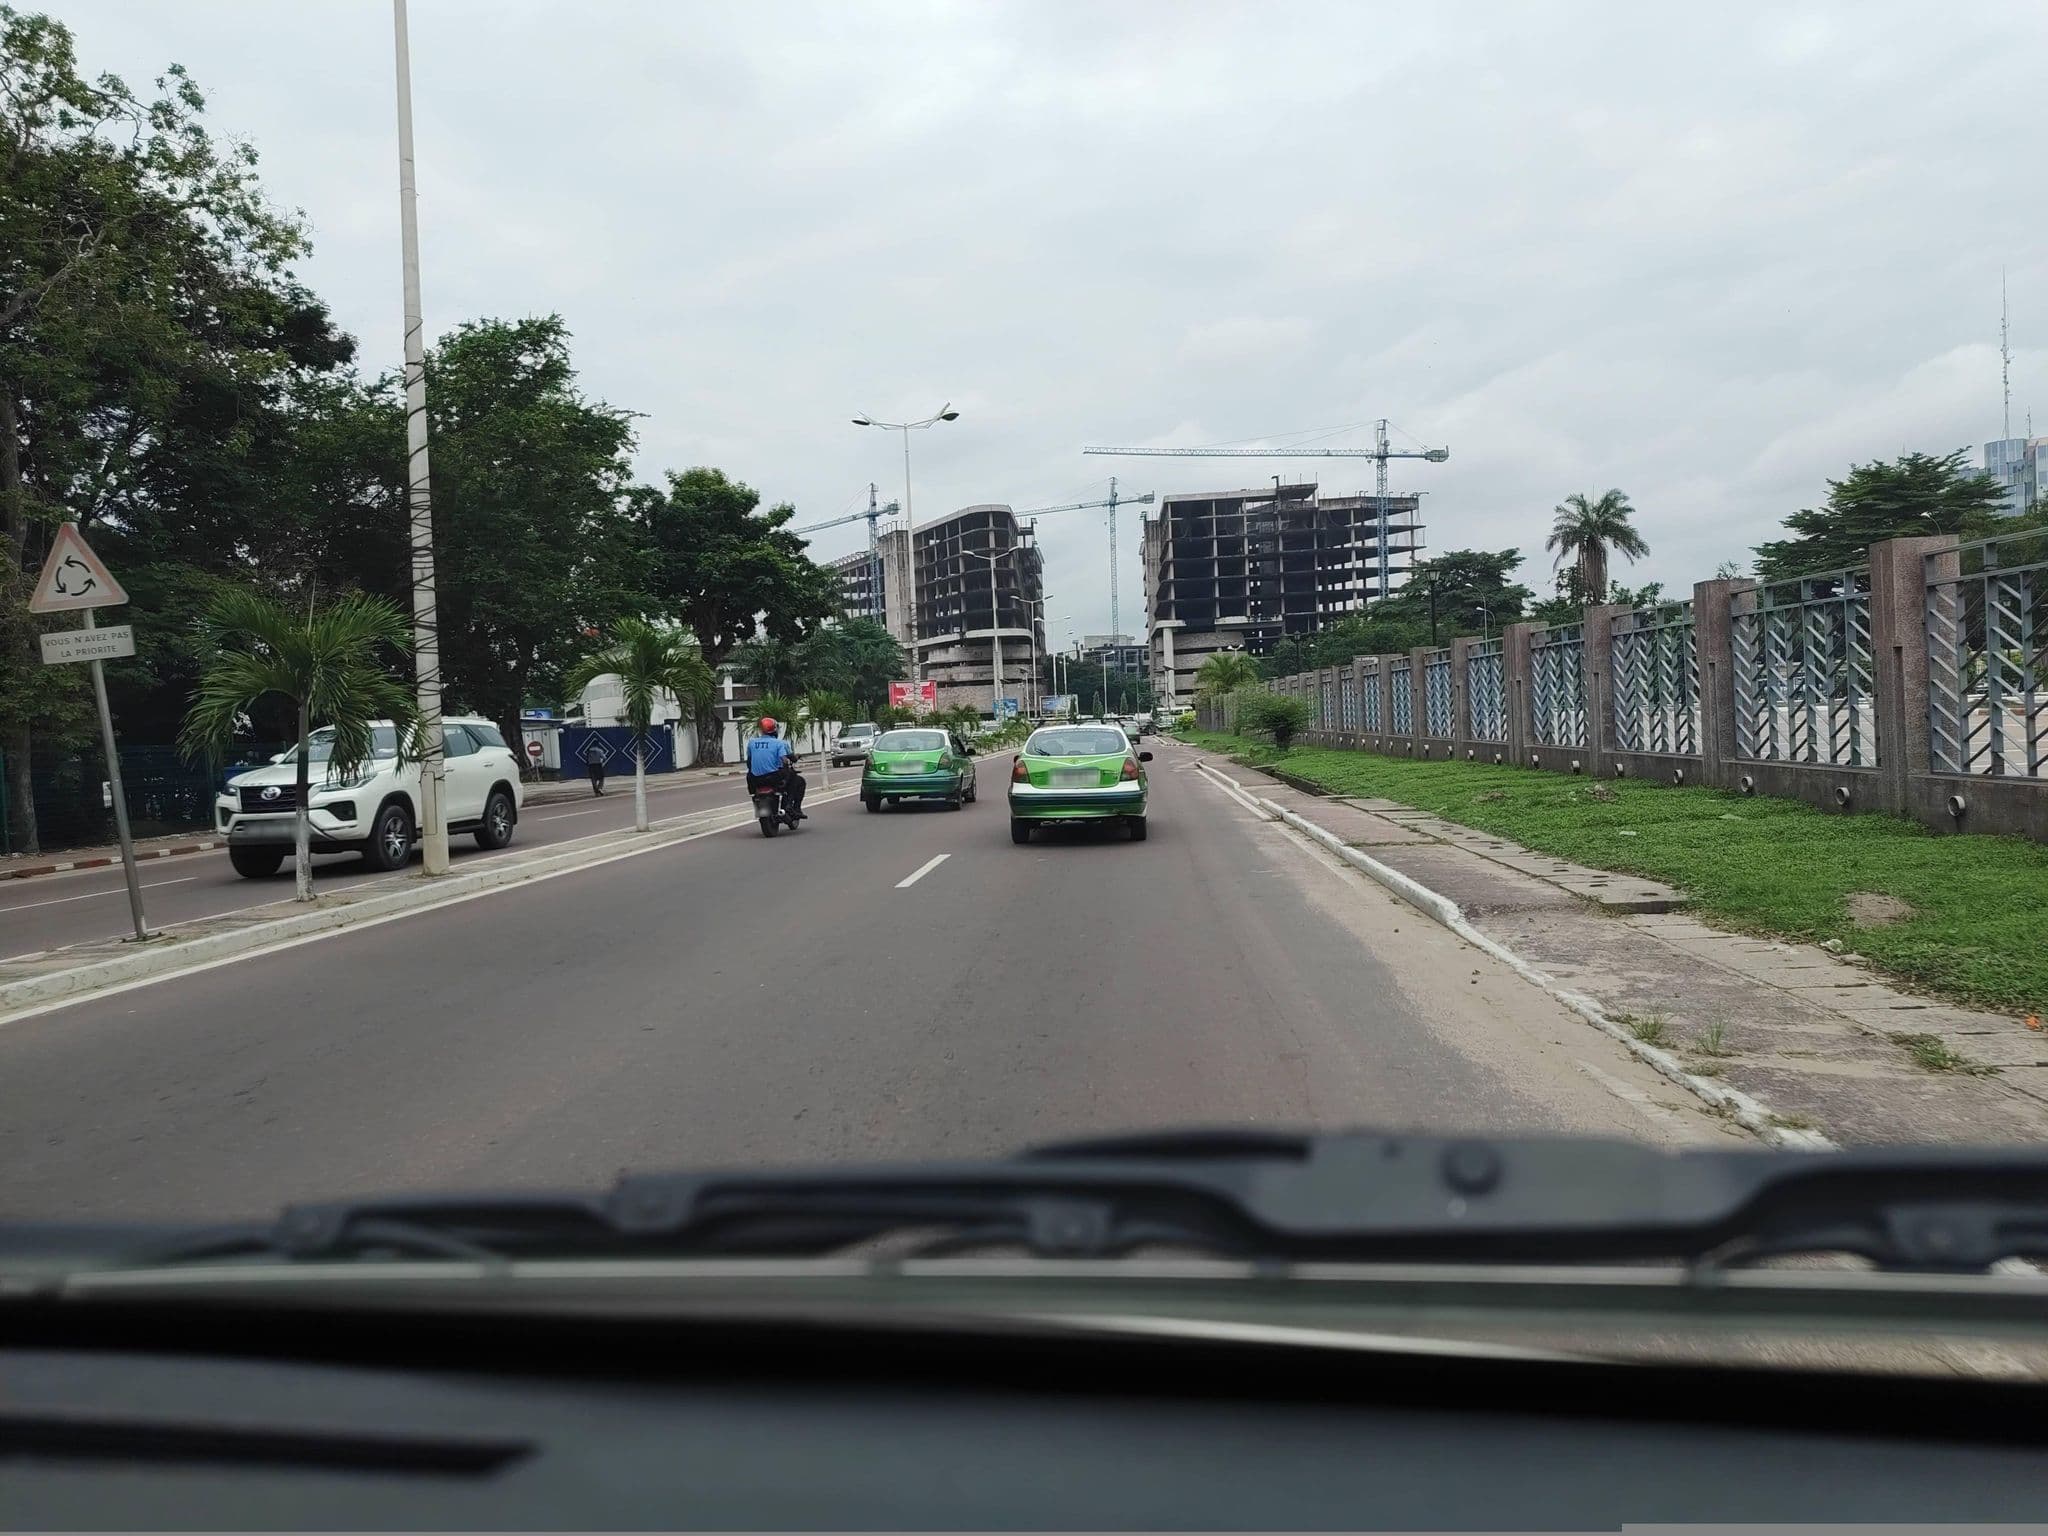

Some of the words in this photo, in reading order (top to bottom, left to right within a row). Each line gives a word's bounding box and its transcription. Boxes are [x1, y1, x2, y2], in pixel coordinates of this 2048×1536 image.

[45, 637, 71, 647] VOUS
[74, 633, 108, 643] N'AVEZ
[111, 631, 129, 640] PAS
[60, 650, 72, 658] LA
[754, 741, 770, 749] UTI
